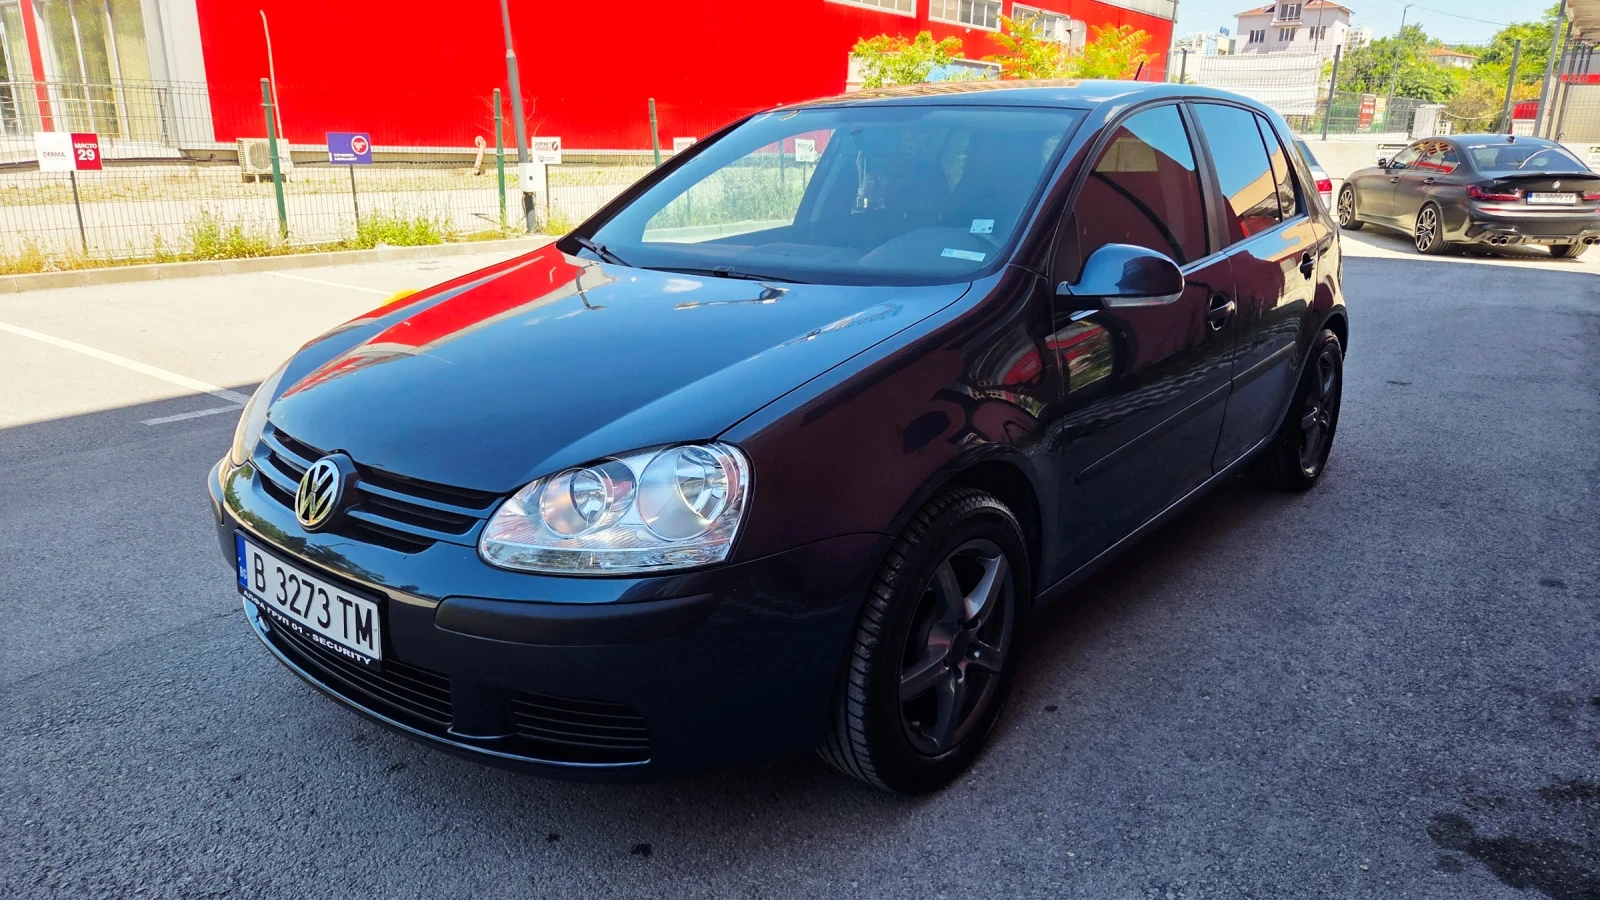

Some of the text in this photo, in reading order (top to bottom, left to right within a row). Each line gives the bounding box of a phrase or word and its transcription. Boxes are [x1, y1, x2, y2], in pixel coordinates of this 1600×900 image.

[77, 149, 96, 161] 29
[295, 459, 340, 527] VW
[239, 565, 247, 580] BG
[253, 551, 374, 651] B 3273 TM
[267, 606, 290, 627] ГРУП
[291, 623, 303, 634] 01
[312, 633, 372, 665] SECURITY
